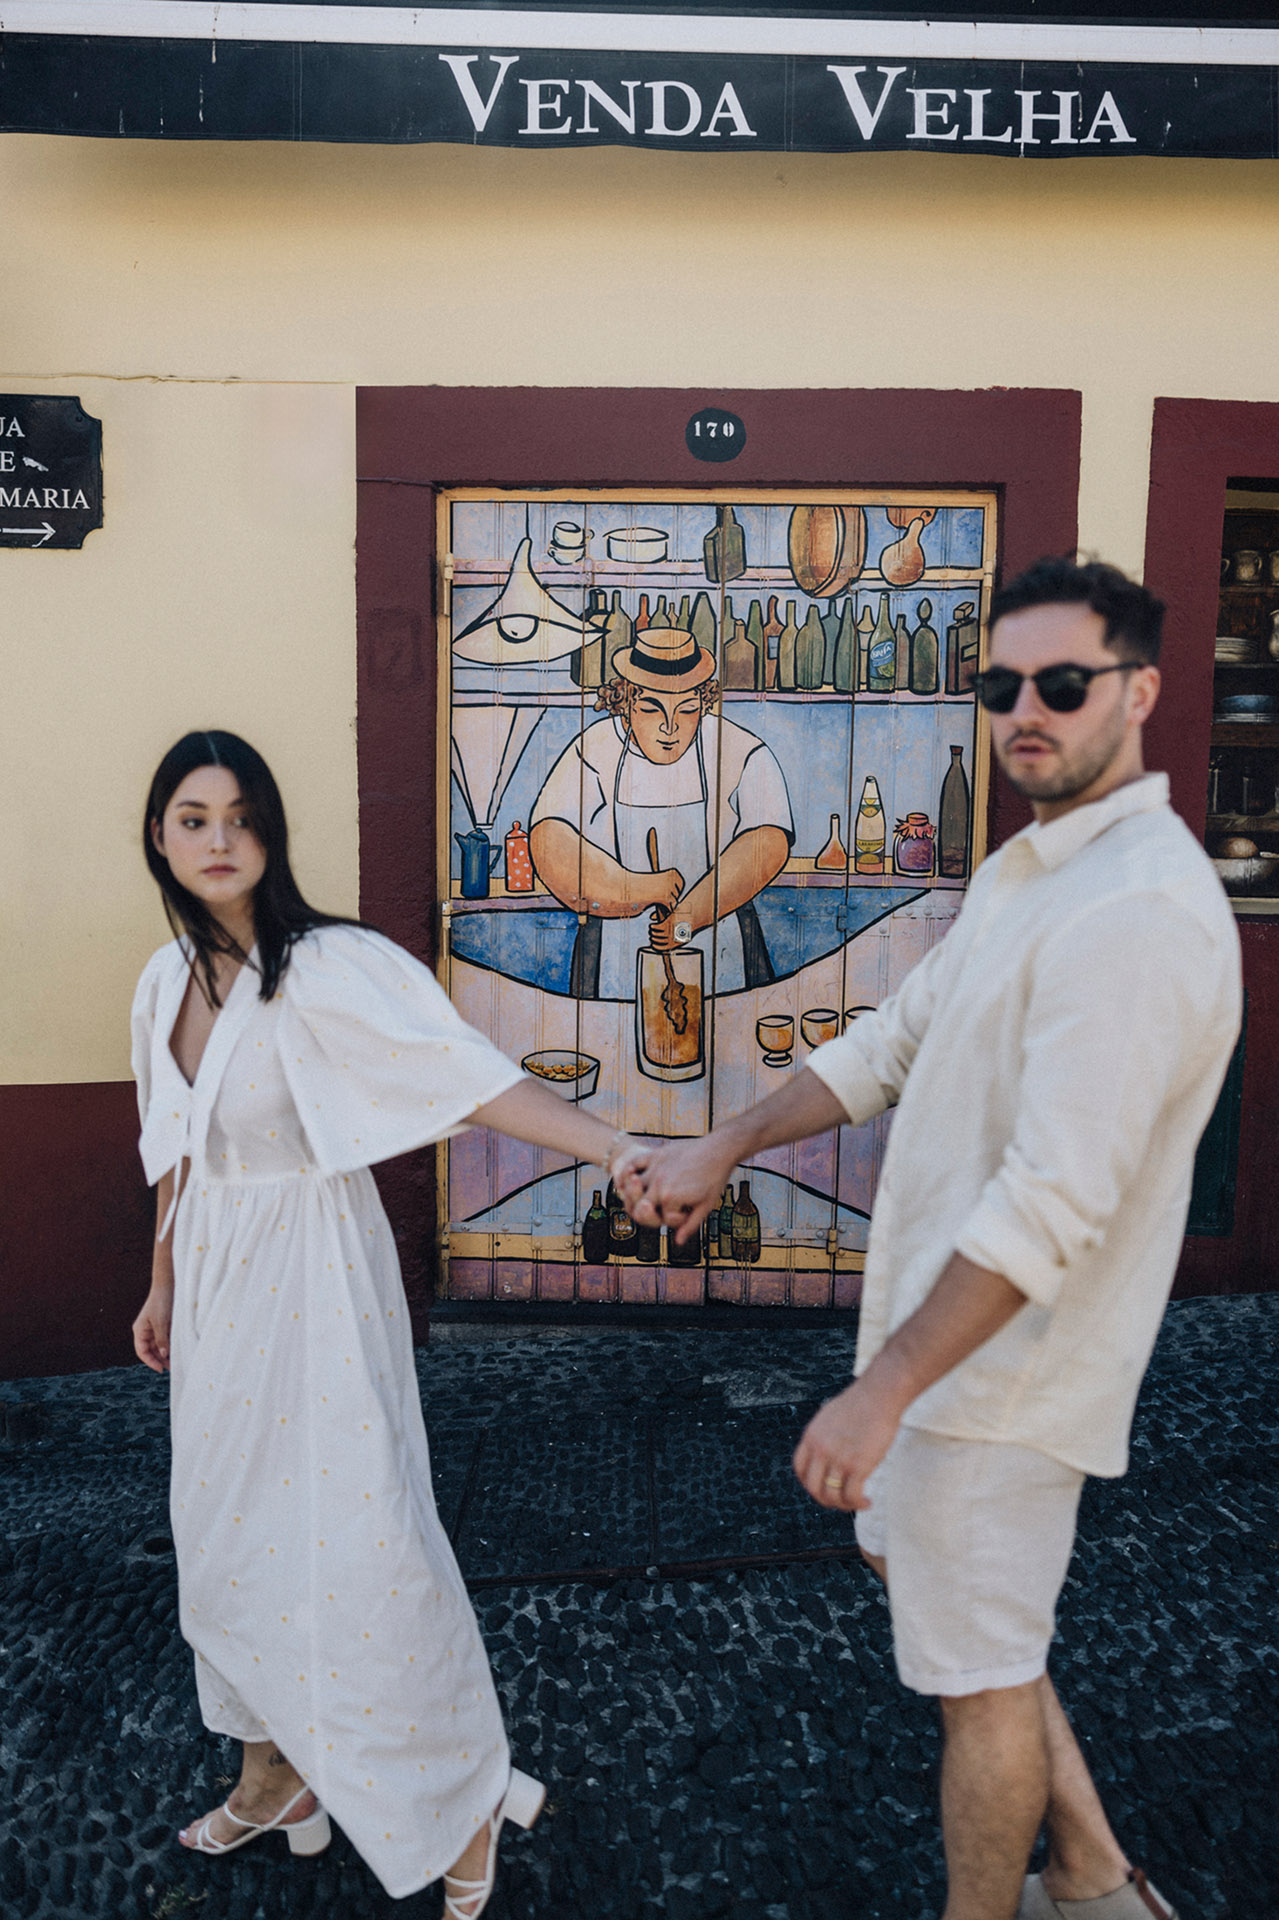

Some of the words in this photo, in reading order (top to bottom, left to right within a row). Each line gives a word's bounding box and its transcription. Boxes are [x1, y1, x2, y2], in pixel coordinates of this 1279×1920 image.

[438, 54, 757, 137] VENDA
[827, 65, 1137, 144] VELHA
[694, 420, 735, 438] 170
[0, 487, 90, 509] MARIA
